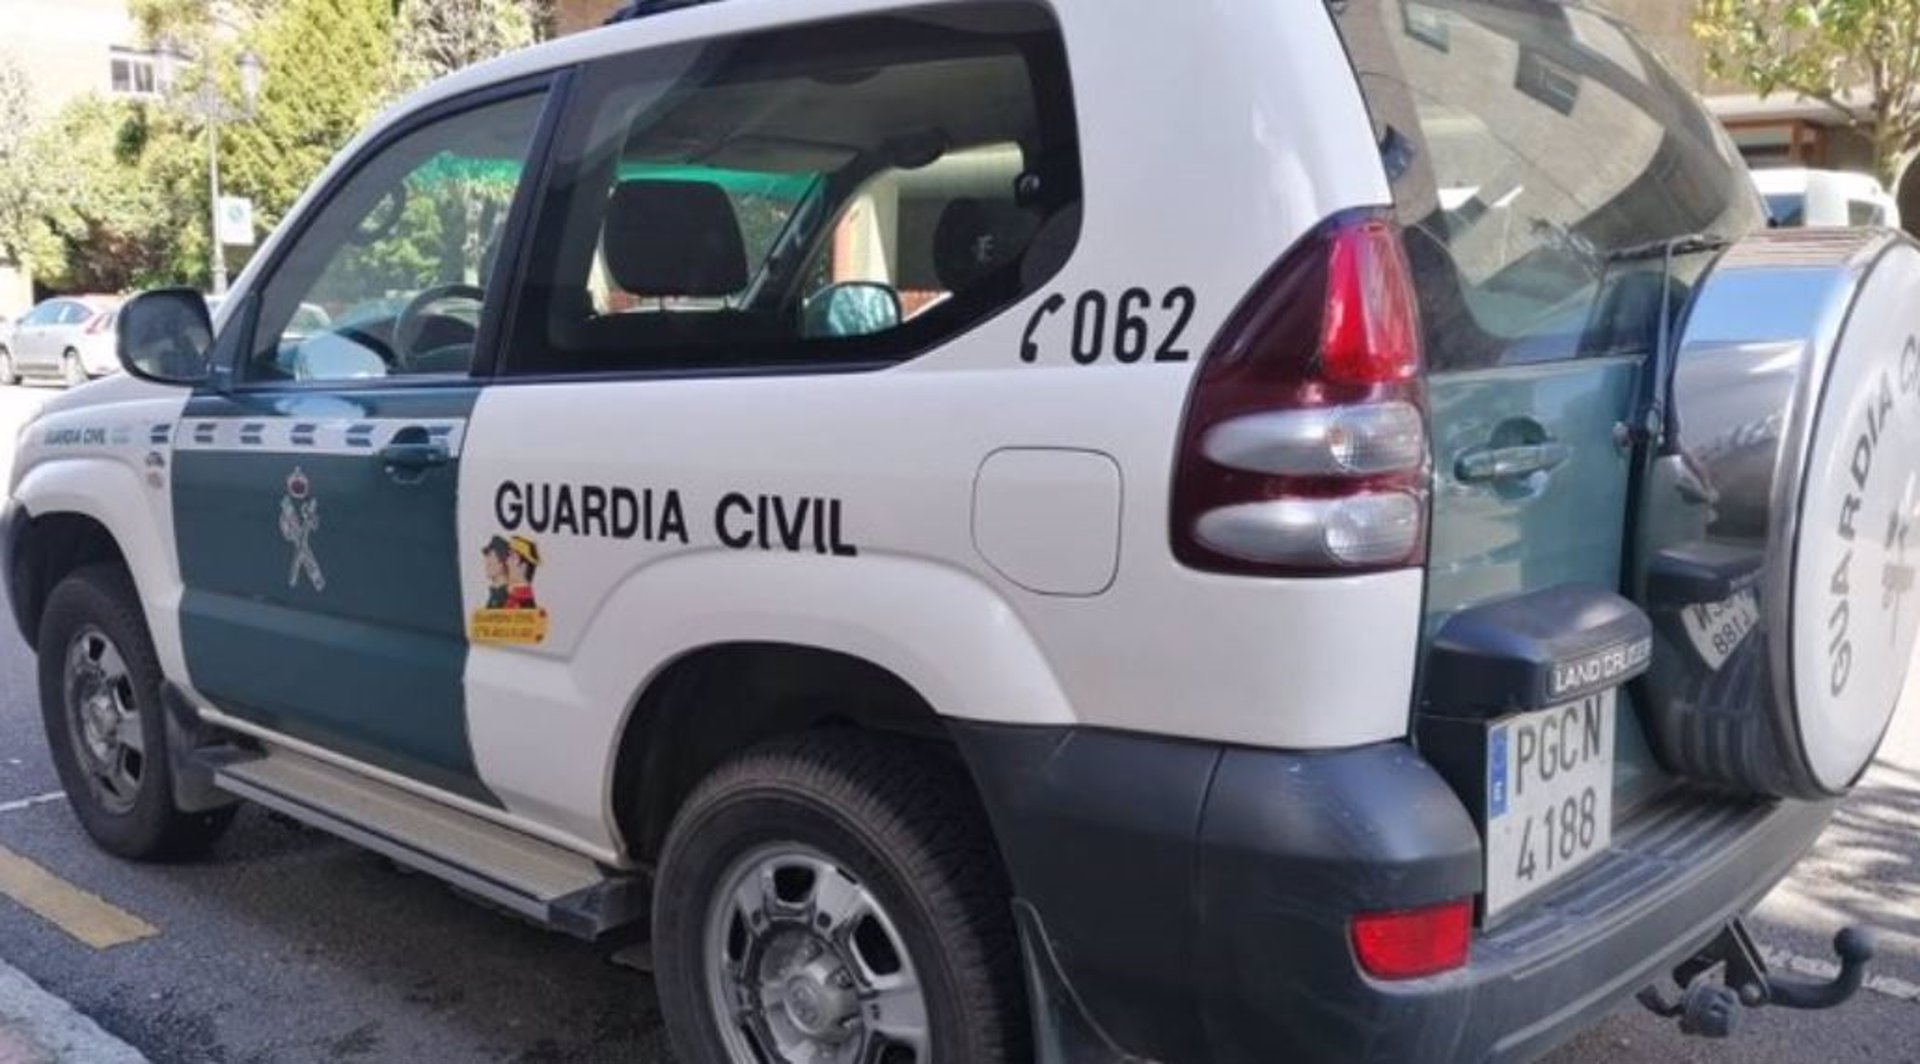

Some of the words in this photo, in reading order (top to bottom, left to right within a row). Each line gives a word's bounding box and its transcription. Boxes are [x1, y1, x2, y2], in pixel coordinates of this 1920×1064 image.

[1070, 284, 1196, 365] 062
[494, 480, 690, 544] GUARDIA
[714, 491, 858, 557] CIVIL
[1554, 658, 1600, 692] LAND
[1515, 696, 1601, 795] PGCN
[1516, 786, 1597, 882] 4188
